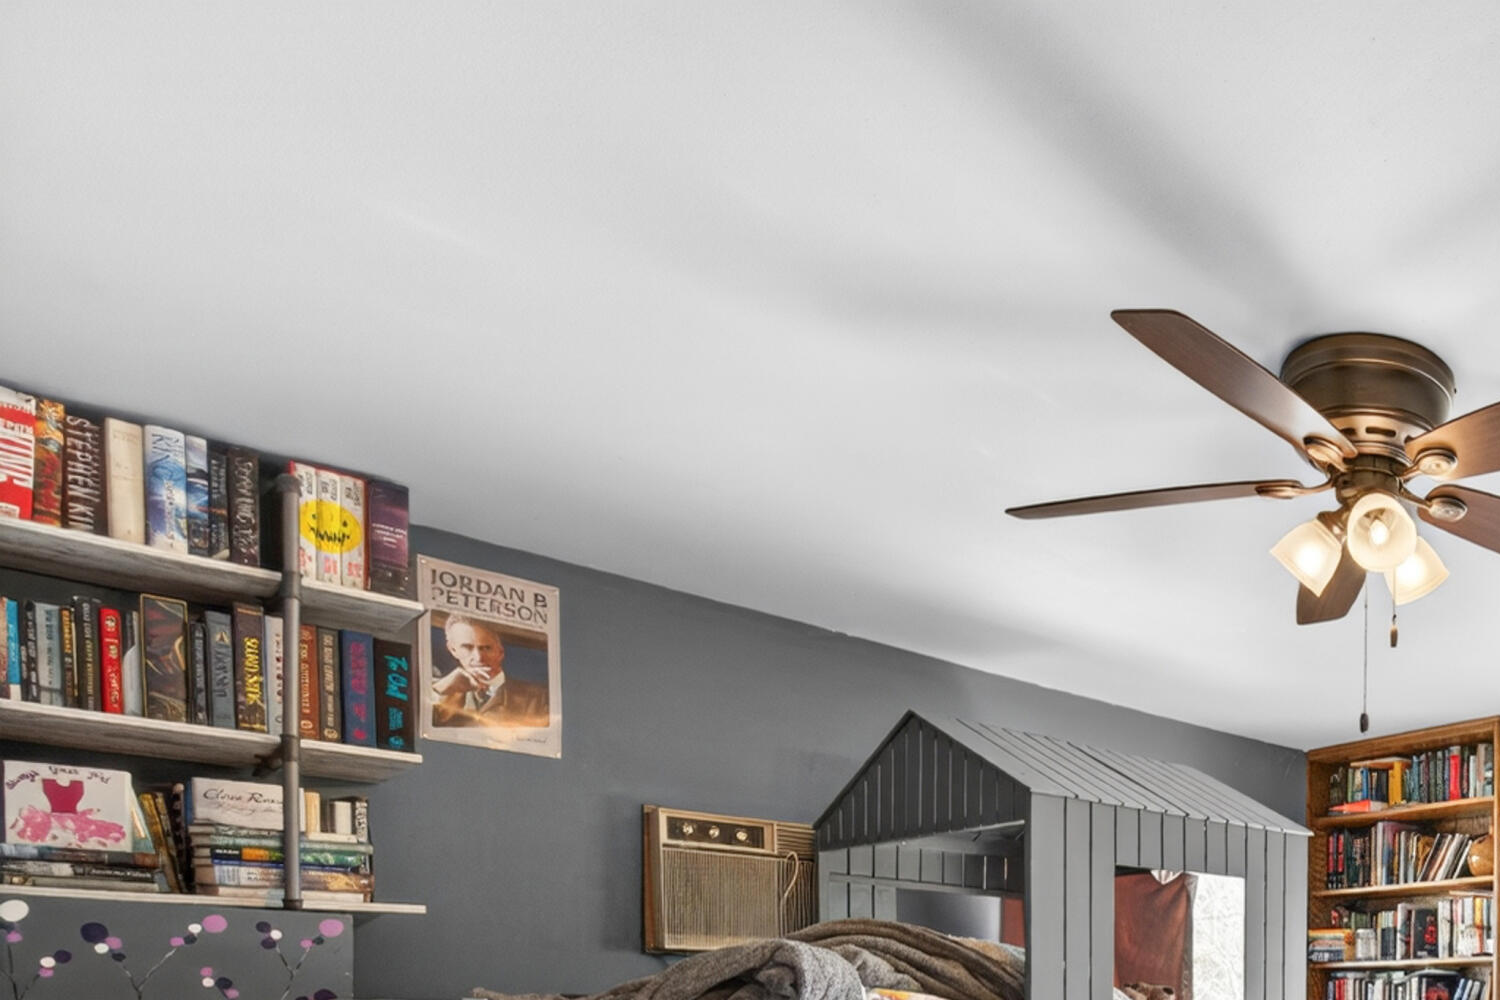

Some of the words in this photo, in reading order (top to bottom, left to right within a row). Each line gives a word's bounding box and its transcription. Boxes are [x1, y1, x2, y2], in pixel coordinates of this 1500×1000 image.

[66, 415, 100, 502] STEPHEN
[431, 569, 525, 604] JORDAN
[534, 593, 548, 609] B
[432, 587, 548, 625] PETERSON
